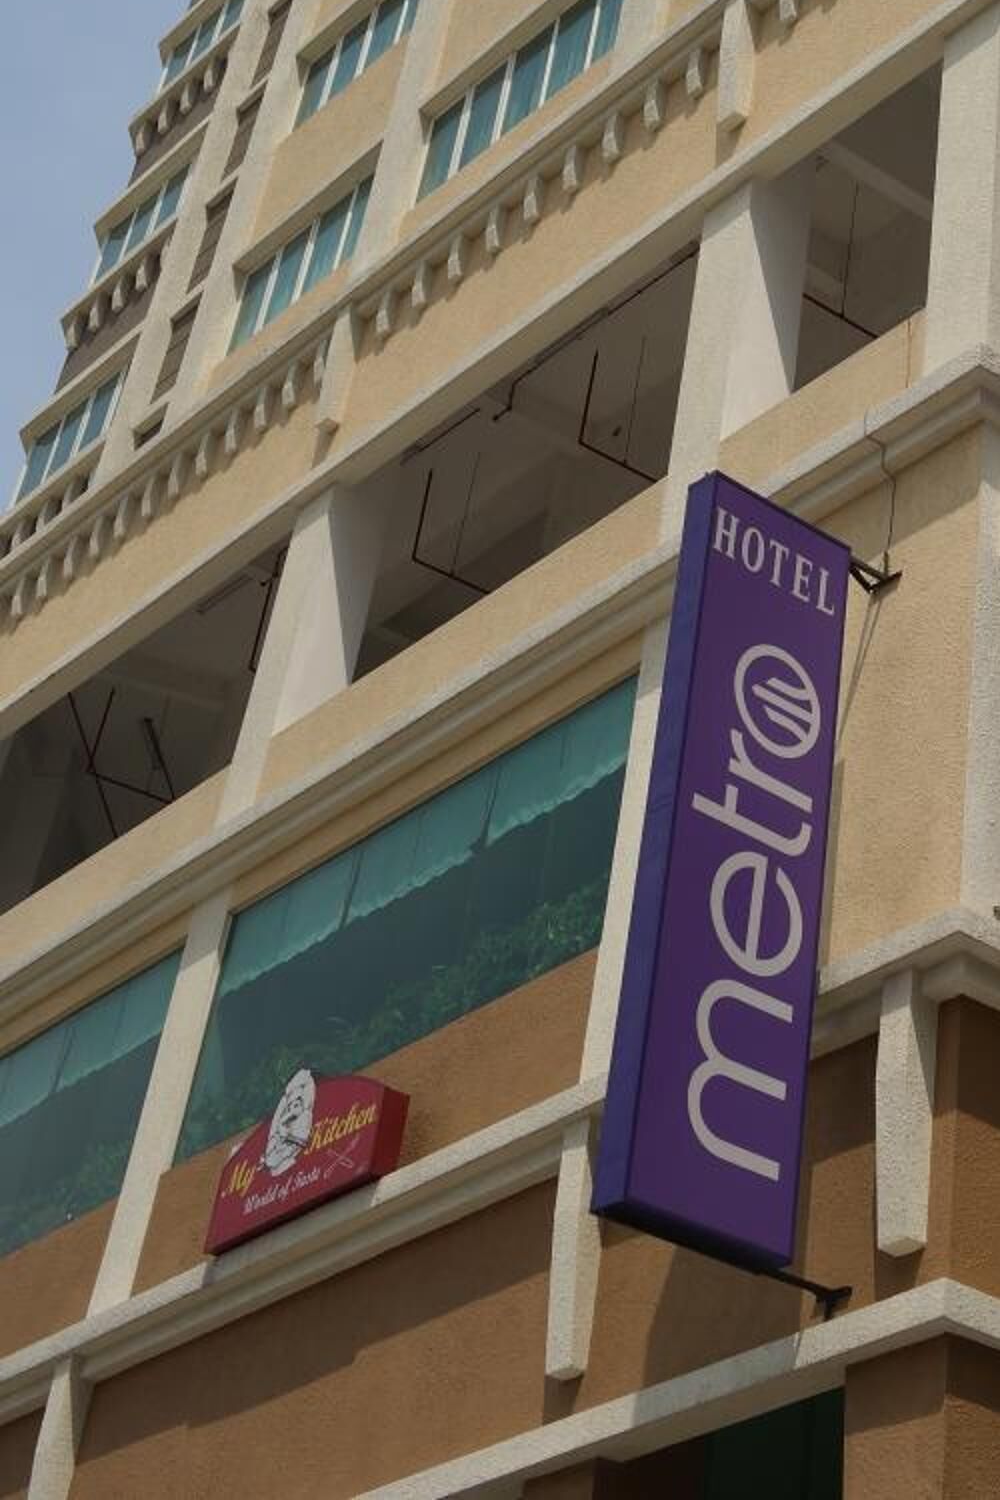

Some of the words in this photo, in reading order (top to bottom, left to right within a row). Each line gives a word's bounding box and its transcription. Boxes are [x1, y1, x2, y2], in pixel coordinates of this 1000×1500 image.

[713, 505, 836, 617] HOTEL
[687, 643, 821, 1183] metro
[223, 1160, 257, 1196] My
[303, 1103, 377, 1155] Kitchen
